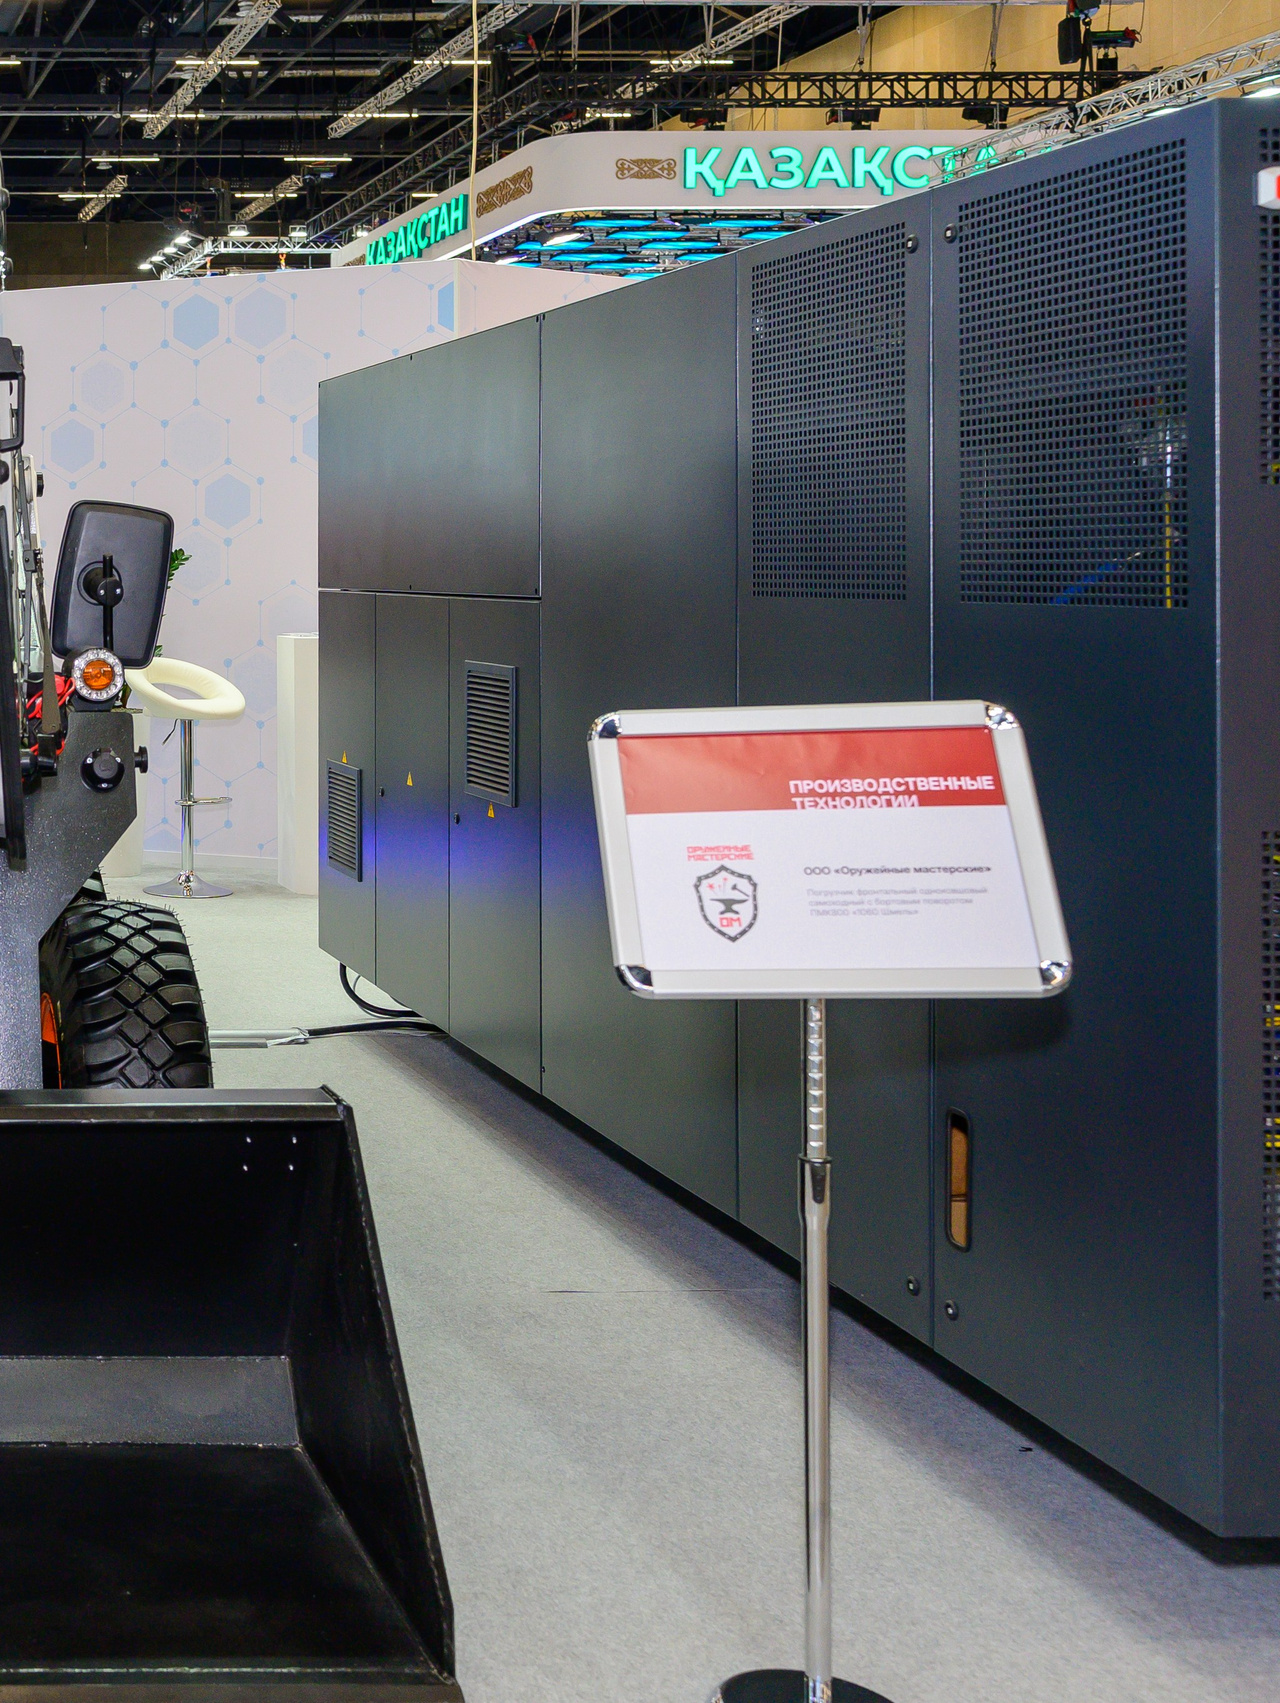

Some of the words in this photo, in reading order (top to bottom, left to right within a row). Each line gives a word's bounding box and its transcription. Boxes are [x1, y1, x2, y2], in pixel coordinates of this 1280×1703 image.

[789, 775, 996, 794] ПРОИЗВОДСТВЕННЫЕ
[791, 794, 920, 810] ТЕХНОЛОГИИ
[804, 866, 831, 876] ООО
[719, 917, 742, 927] ОМ
